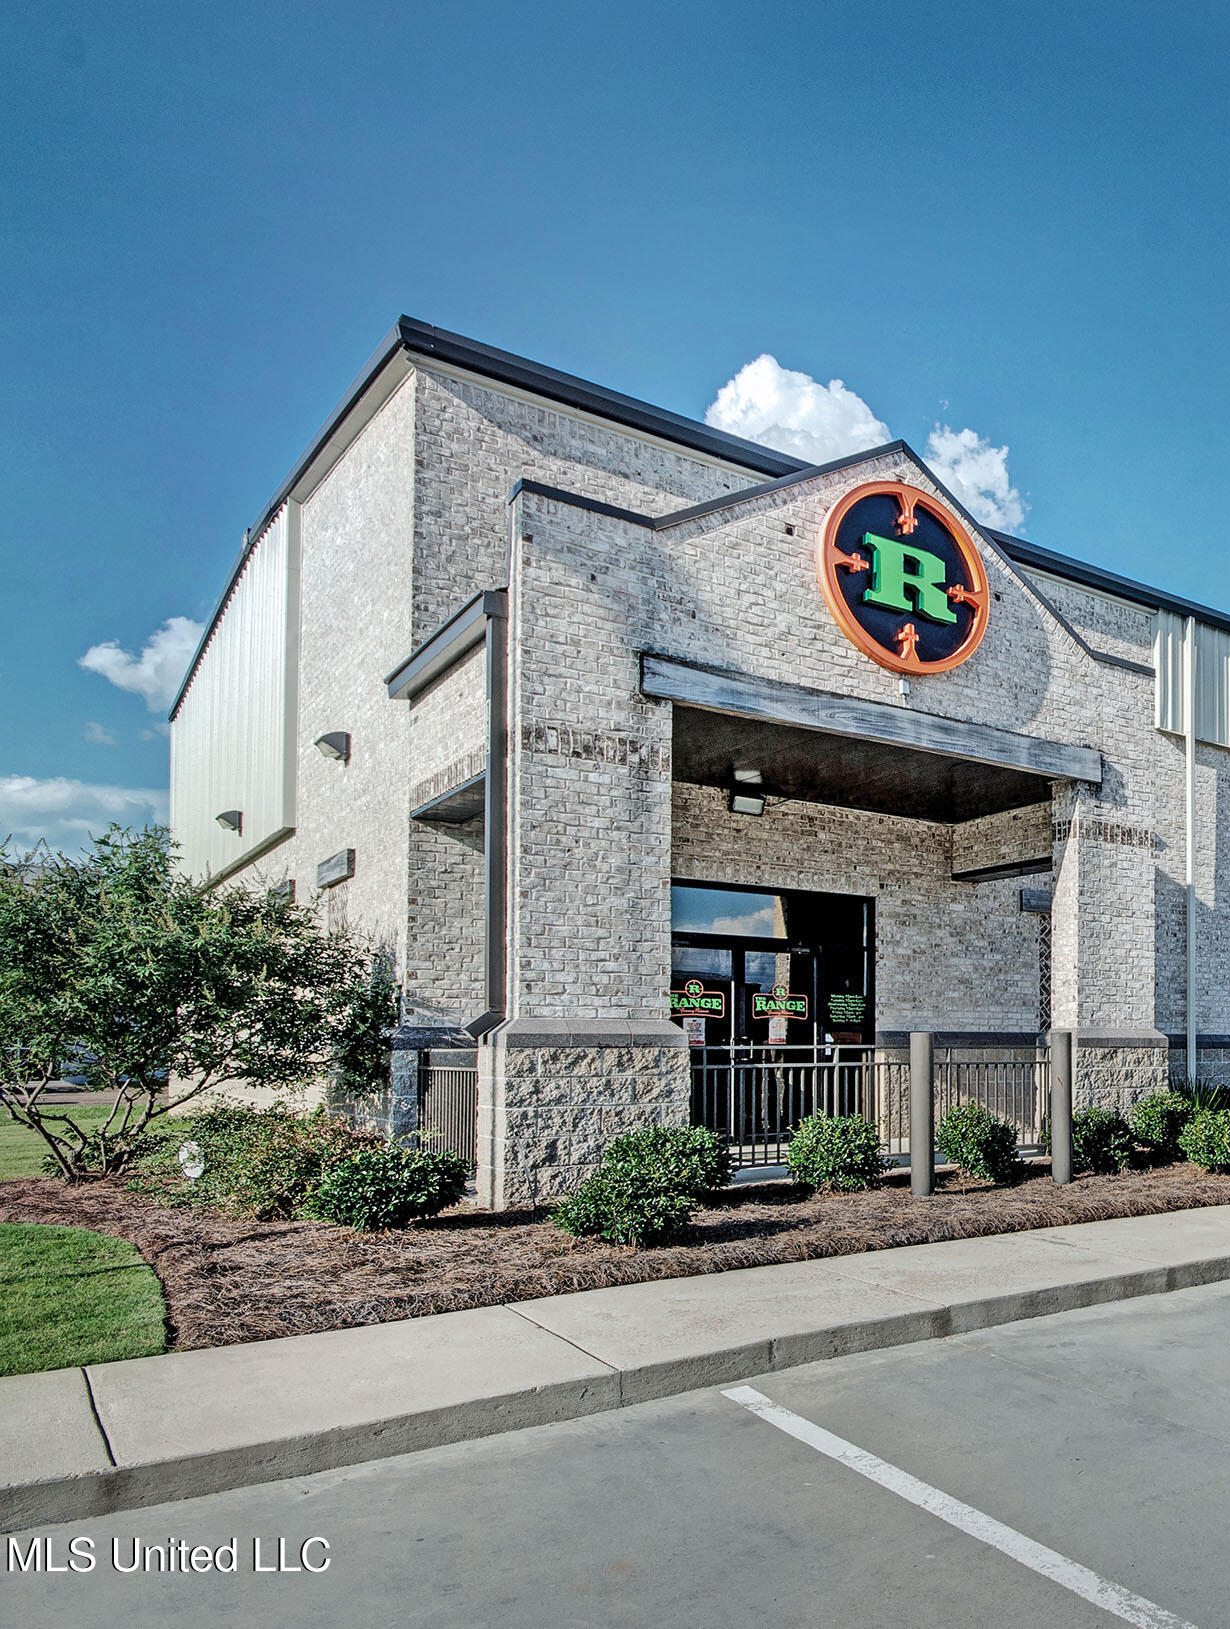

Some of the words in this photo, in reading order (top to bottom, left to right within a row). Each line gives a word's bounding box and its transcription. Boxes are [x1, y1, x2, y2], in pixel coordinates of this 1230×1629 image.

[862, 532, 957, 623] R
[670, 997, 722, 1010] RANGE
[755, 1000, 806, 1012] RANGE
